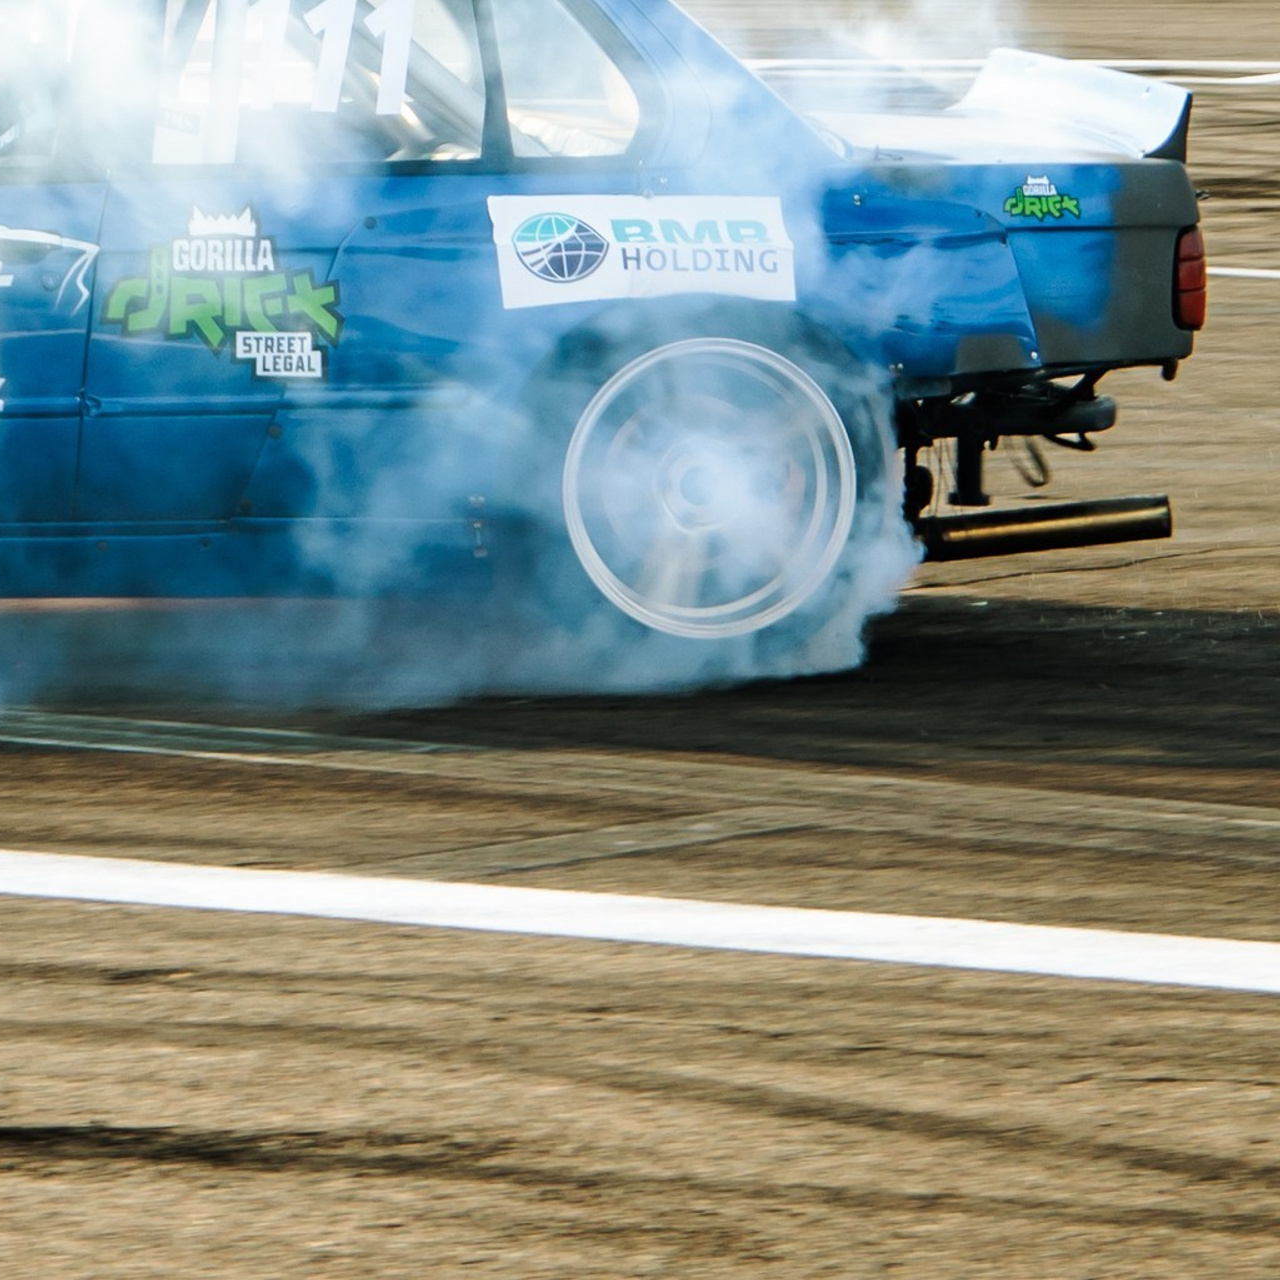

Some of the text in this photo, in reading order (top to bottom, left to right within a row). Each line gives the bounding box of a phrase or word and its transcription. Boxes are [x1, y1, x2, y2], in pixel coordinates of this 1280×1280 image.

[172, 239, 275, 271] GORILLA
[620, 247, 778, 273] HOLDING
[242, 336, 308, 354] STREET
[262, 355, 316, 372] LEGAL
